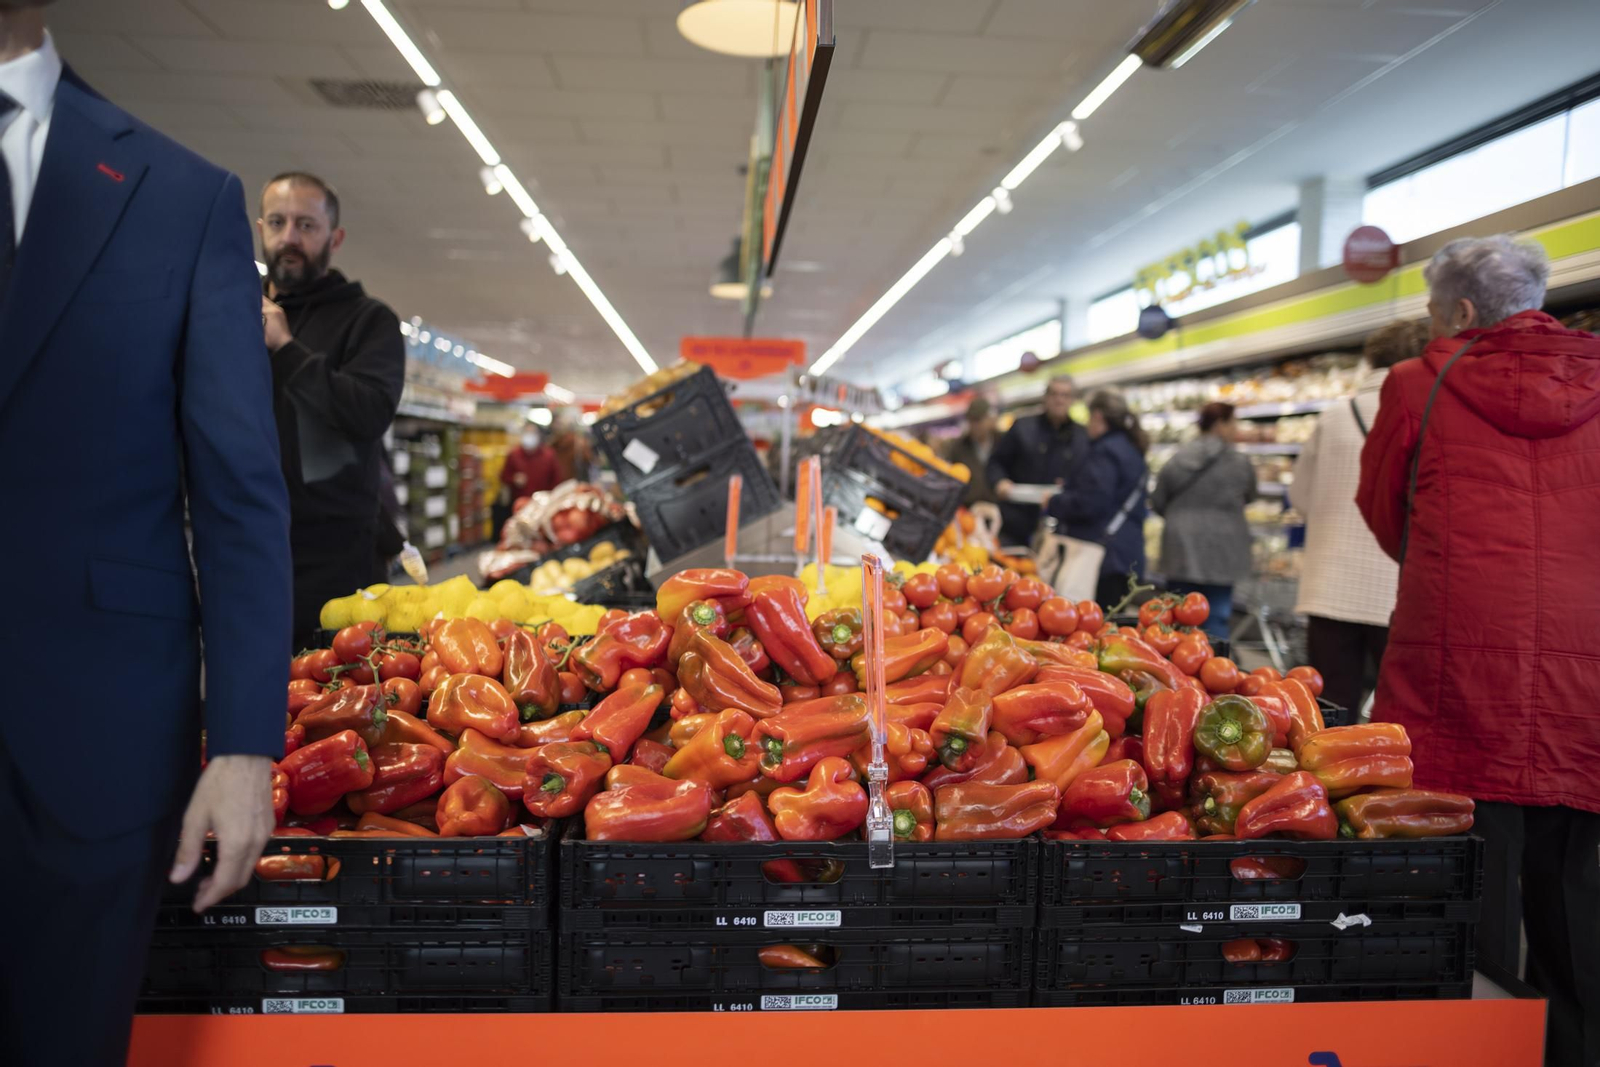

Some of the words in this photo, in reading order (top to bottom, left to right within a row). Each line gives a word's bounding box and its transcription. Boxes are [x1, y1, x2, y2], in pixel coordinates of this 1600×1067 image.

[291, 909, 319, 918] IFCO
[1261, 906, 1286, 914] IFCO
[797, 912, 824, 921] IFCO
[1187, 912, 1198, 920] LL
[1202, 911, 1224, 920] 6410
[221, 915, 247, 925] 6410
[716, 917, 728, 925] LL
[733, 917, 757, 925] 6410
[1255, 991, 1279, 999] IFCO
[794, 996, 821, 1004] IFCO
[1181, 997, 1192, 1005] LL
[298, 1000, 326, 1009] IFCO
[714, 1003, 725, 1011] LL
[730, 1003, 753, 1011] 6410
